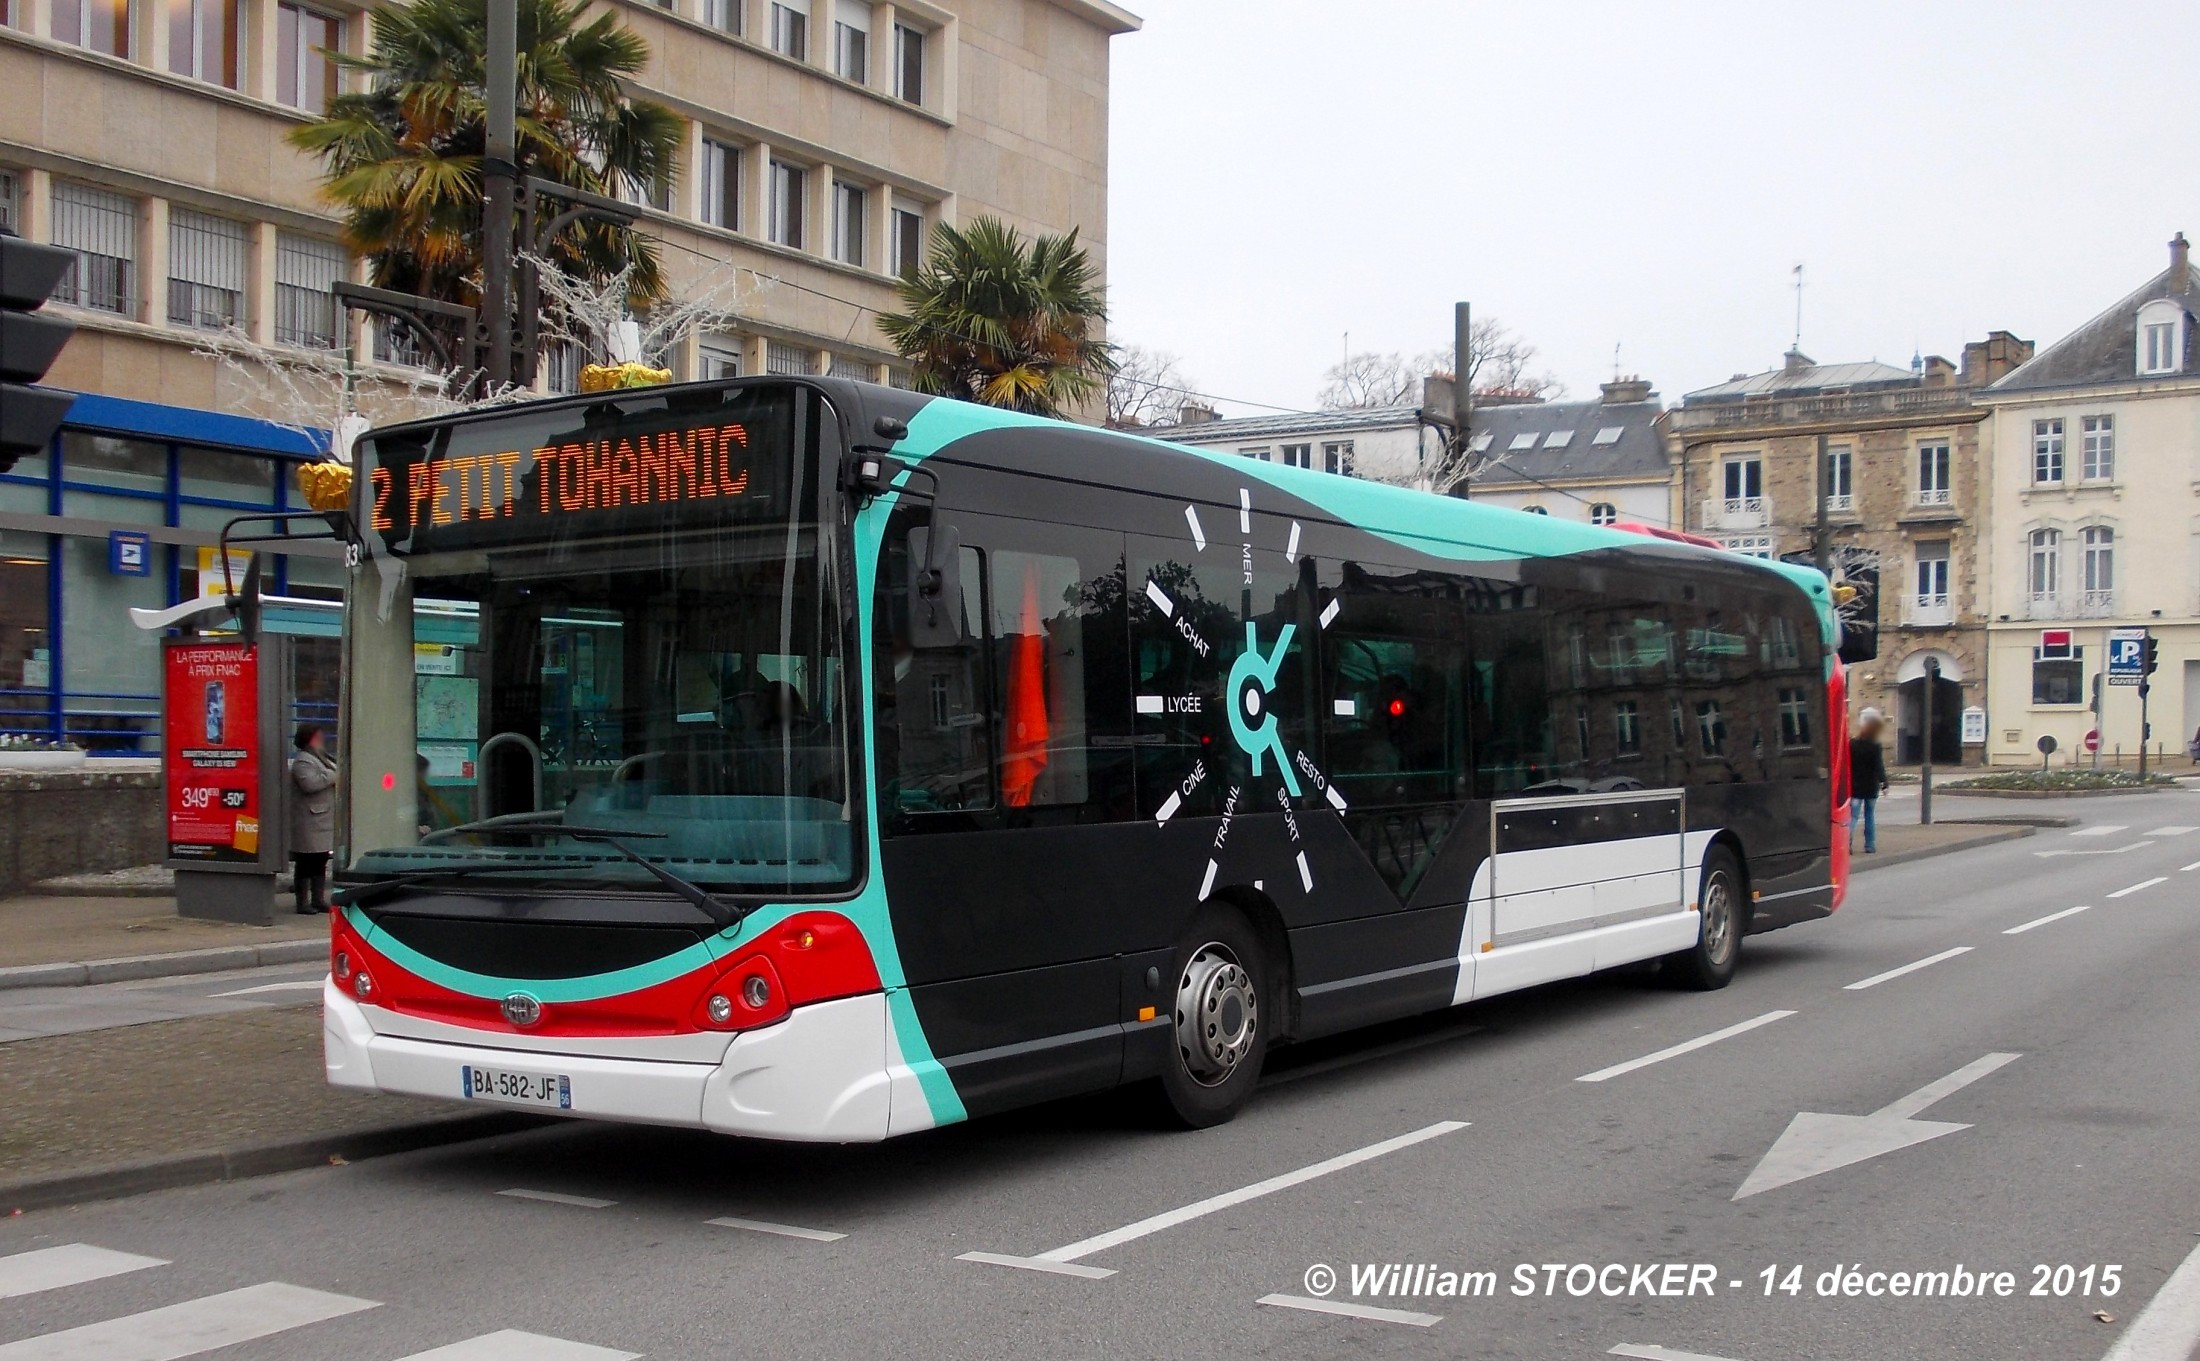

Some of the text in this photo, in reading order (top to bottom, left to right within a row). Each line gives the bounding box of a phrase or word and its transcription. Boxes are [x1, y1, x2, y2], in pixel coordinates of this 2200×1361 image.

[370, 424, 748, 531] 2 PETIT TOHANNIC
[1242, 542, 1253, 586] MER
[1175, 615, 1211, 660] ACHAT
[2121, 641, 2140, 663] P
[176, 651, 188, 664] LA
[195, 664, 214, 676] PRIX
[216, 663, 241, 676] FNAC
[1167, 691, 1202, 713] LYCÉE
[1181, 759, 1208, 797] CINÉ
[1295, 749, 1326, 791] RESTO
[235, 820, 259, 833] fnac
[1213, 784, 1241, 850] TRAVAIL
[1276, 787, 1300, 843] SPORT
[474, 1070, 555, 1100] BA-582-JF
